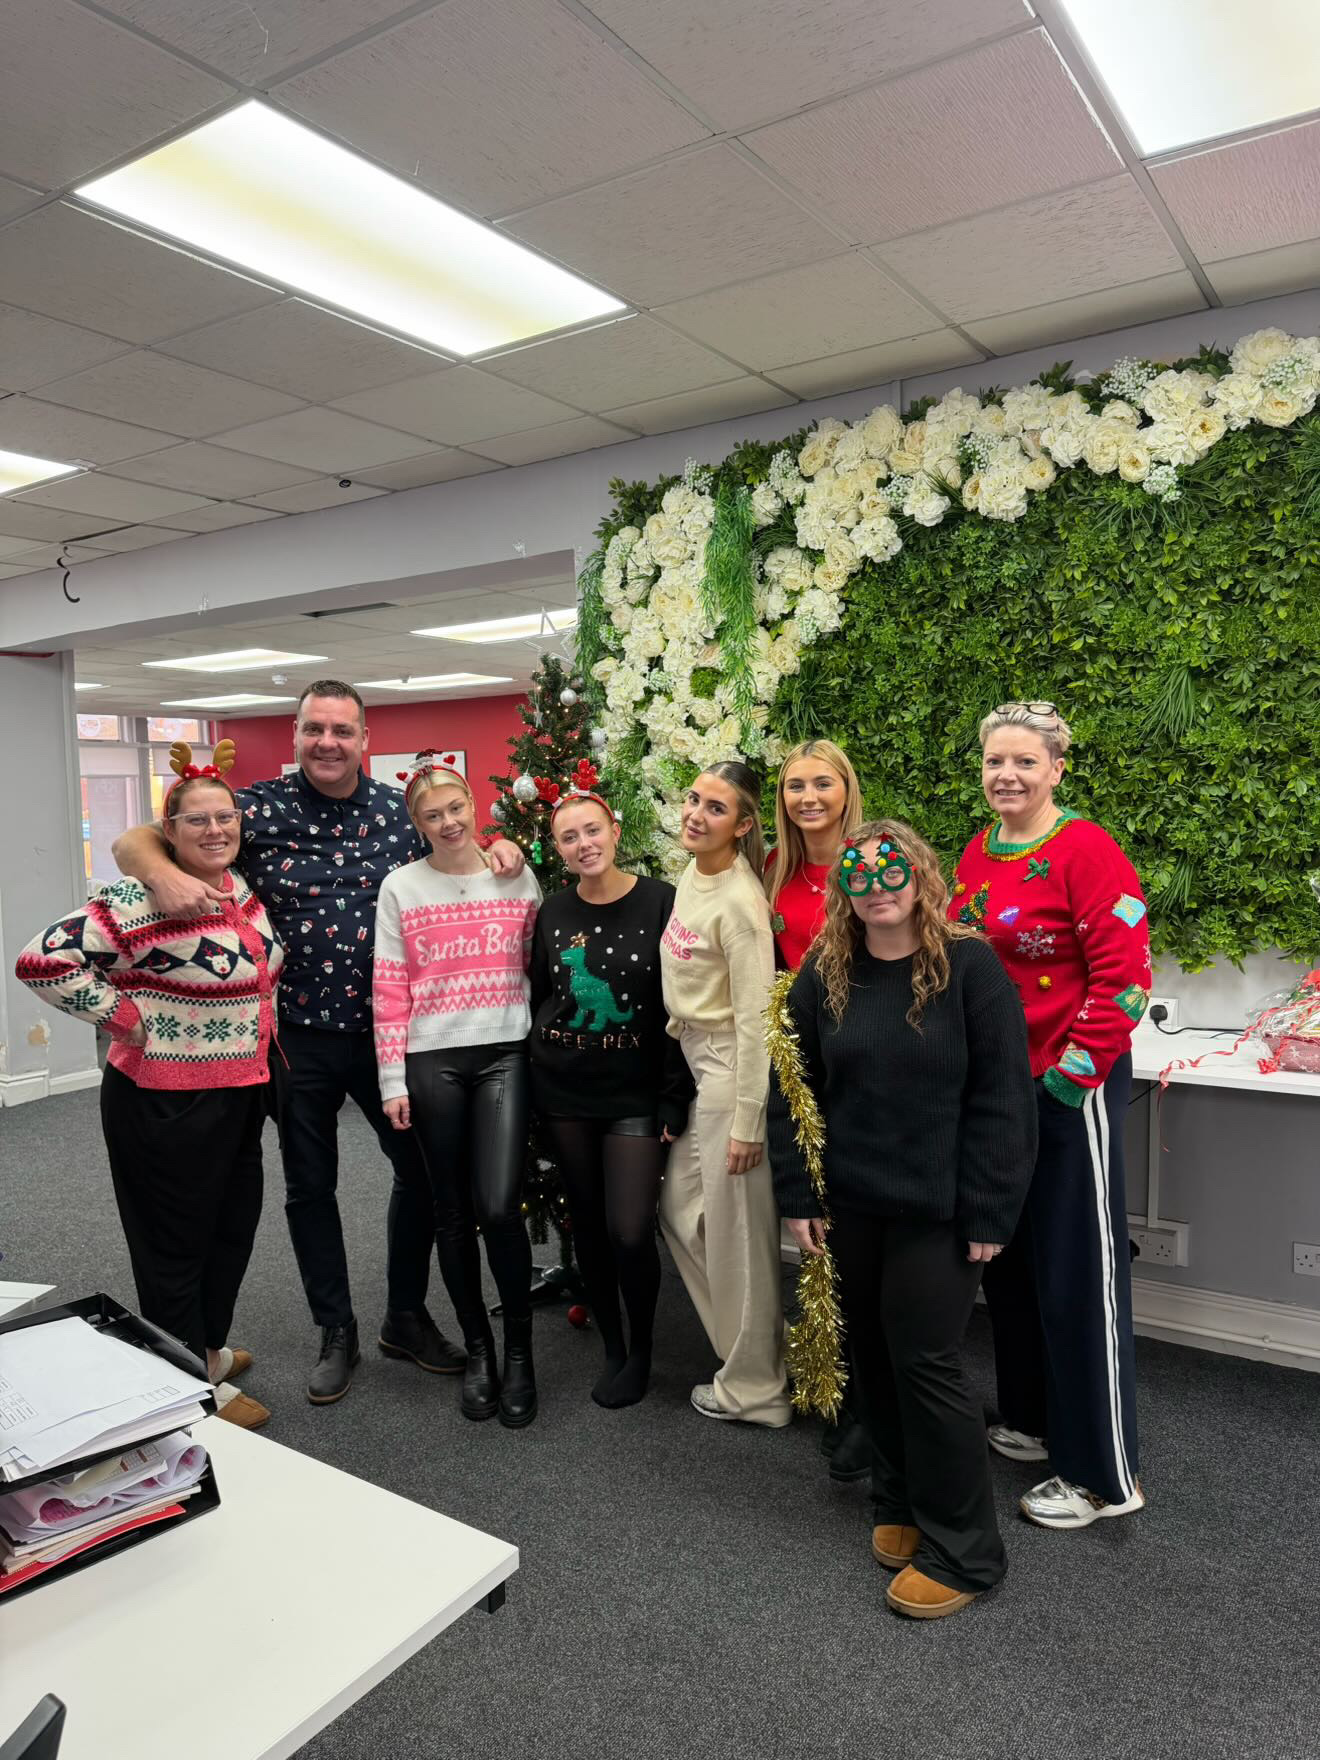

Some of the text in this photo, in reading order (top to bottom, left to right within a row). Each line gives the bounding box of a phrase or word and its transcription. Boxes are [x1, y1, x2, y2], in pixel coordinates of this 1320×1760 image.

[414, 923, 521, 967] Santa Bab
[670, 917, 699, 945] GIVING
